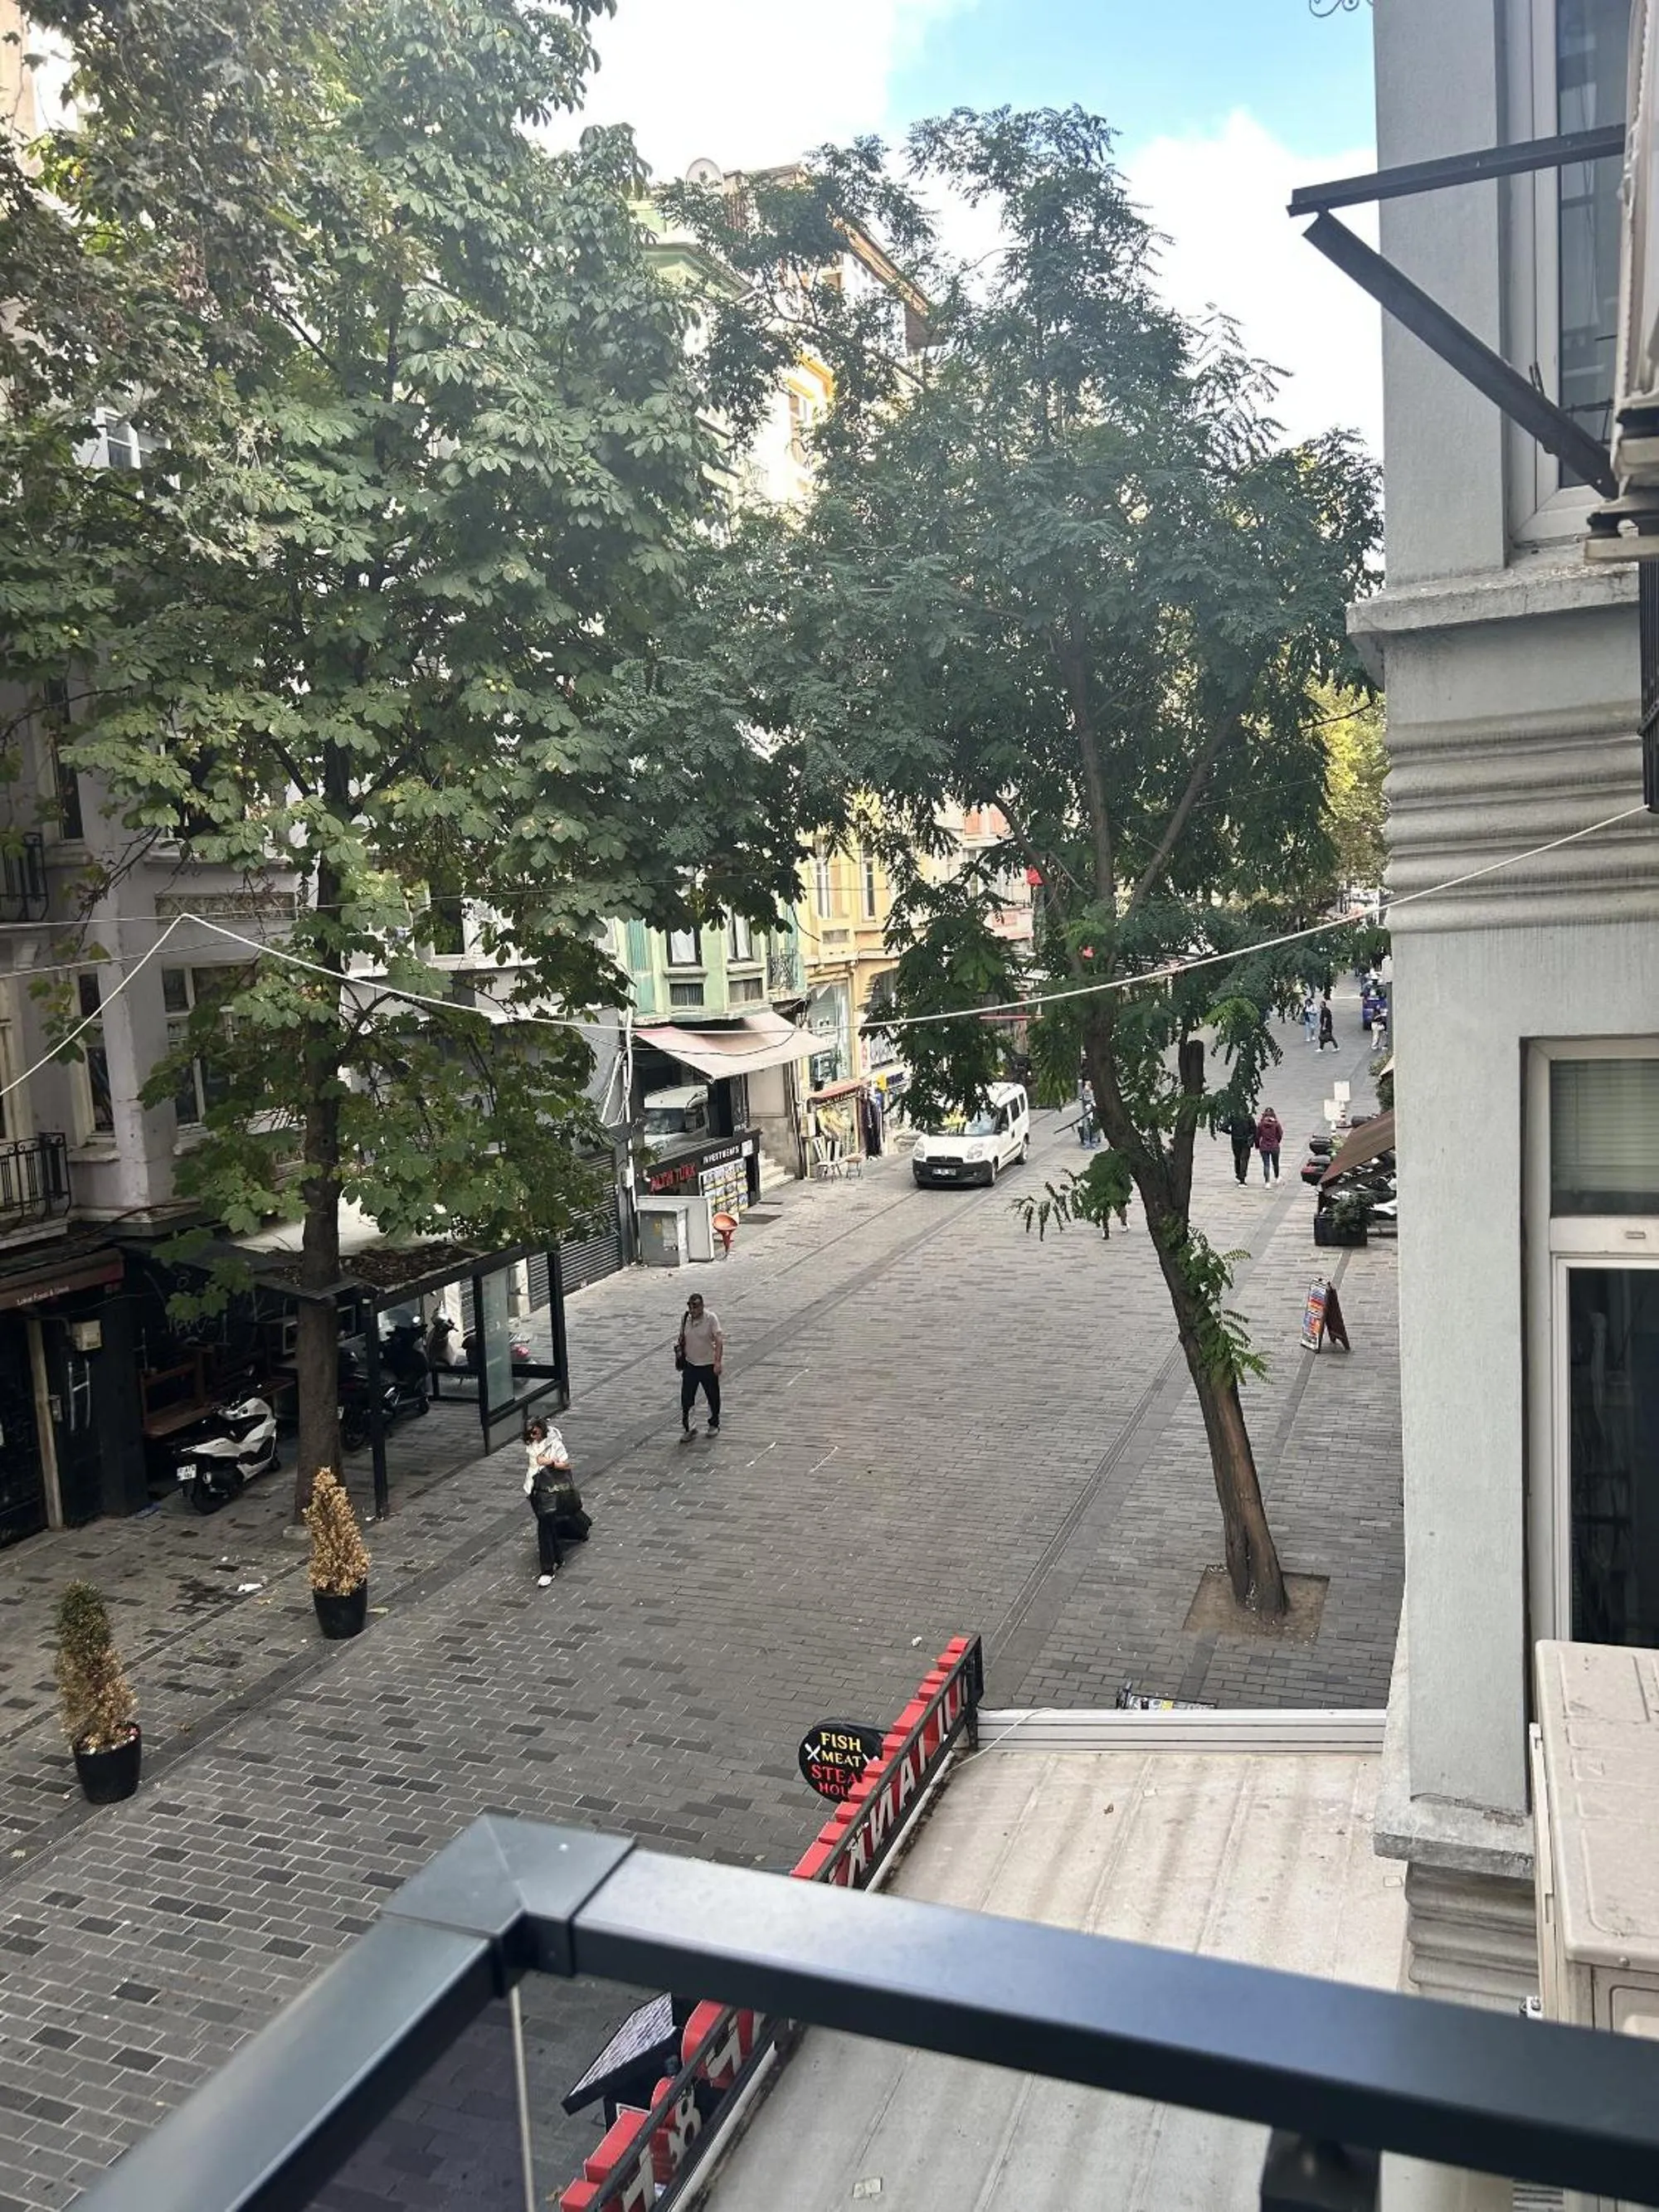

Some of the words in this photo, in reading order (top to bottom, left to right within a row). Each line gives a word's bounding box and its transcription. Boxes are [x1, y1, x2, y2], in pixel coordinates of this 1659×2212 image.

[820, 1732, 862, 1753] FISH
[821, 1749, 862, 1768] MEAT
[811, 1764, 859, 1783] STEA
[819, 1782, 850, 1798] HOU
